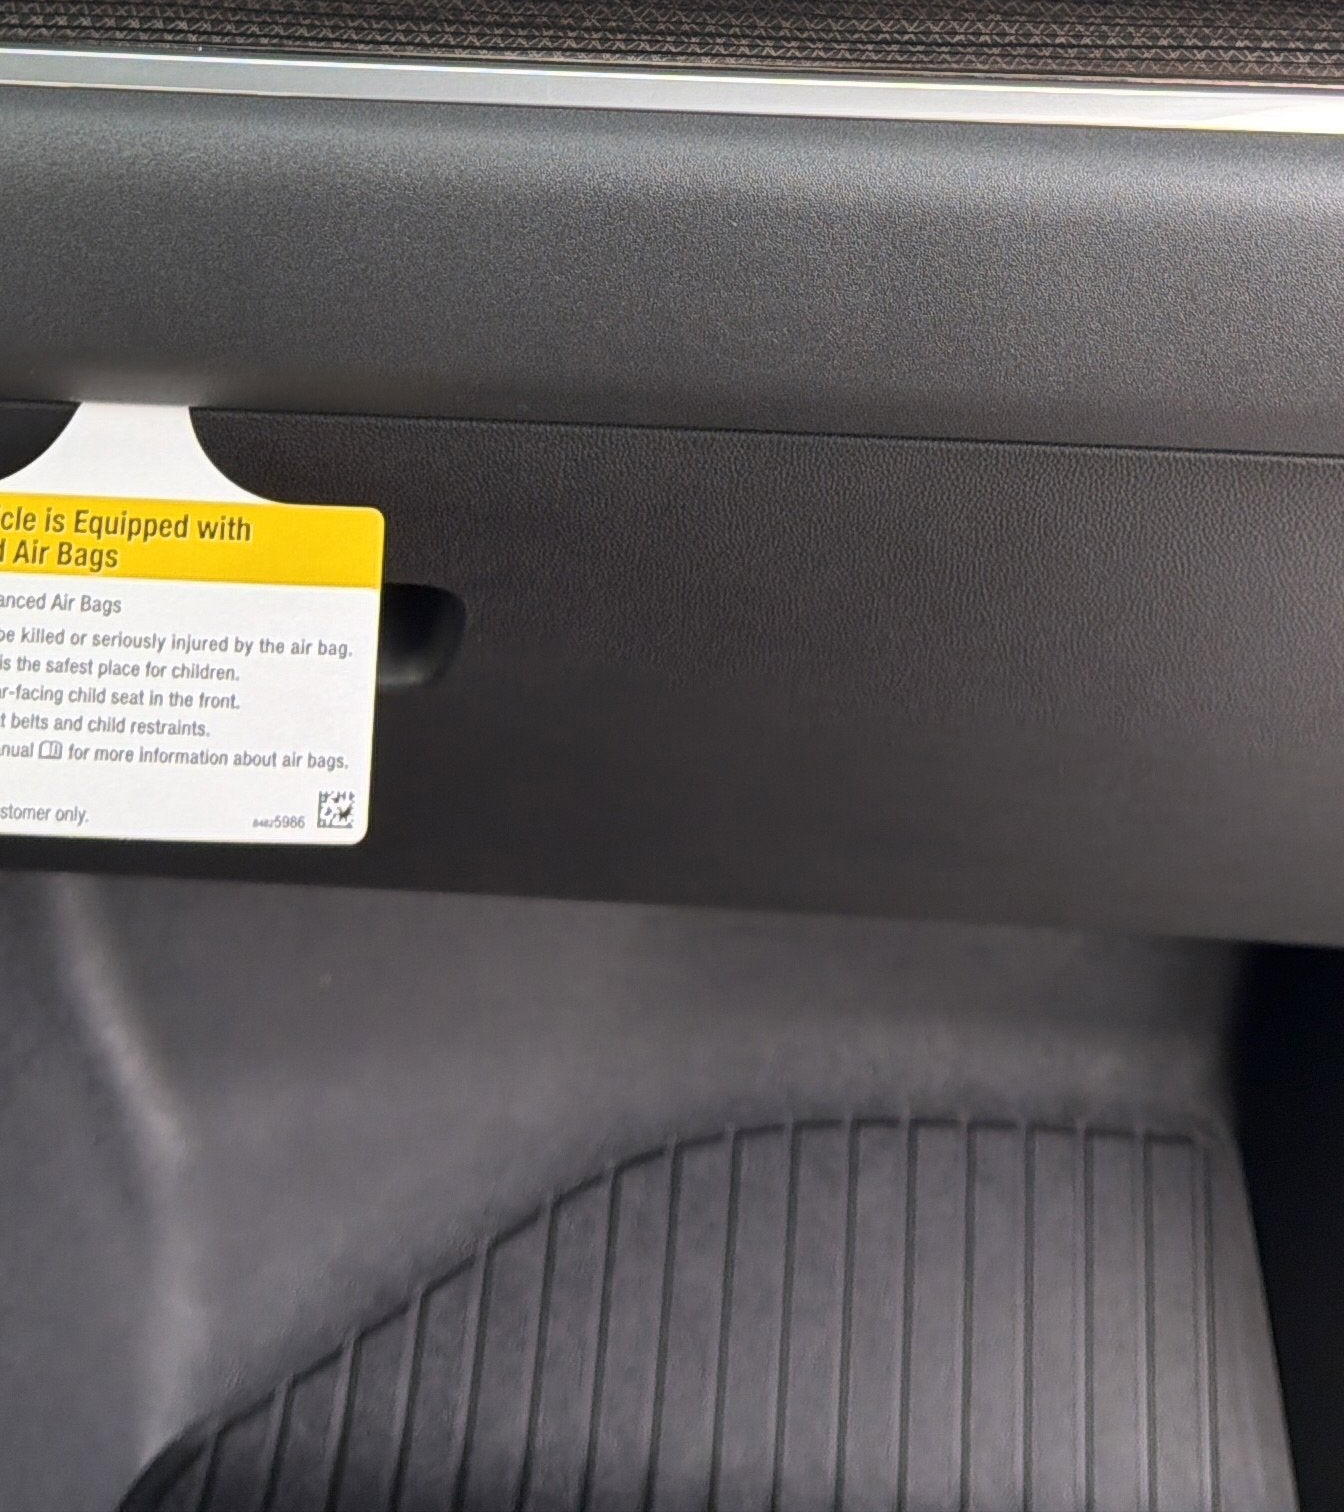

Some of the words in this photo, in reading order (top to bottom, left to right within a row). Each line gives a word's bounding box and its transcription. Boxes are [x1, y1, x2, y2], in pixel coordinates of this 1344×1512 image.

[45, 507, 65, 533] is
[74, 509, 189, 541] Equipped
[197, 515, 251, 541] with
[12, 540, 50, 564] Air
[57, 542, 118, 572] Bags
[50, 593, 76, 611] Air
[80, 594, 122, 616] Bags
[20, 627, 65, 645] killed
[70, 632, 88, 646] or
[92, 631, 166, 652] seriously
[171, 633, 229, 653] injured
[234, 636, 254, 656] by
[259, 638, 285, 654] the
[290, 639, 313, 655] air
[318, 639, 352, 660] bag.
[16, 655, 41, 673] the
[46, 657, 94, 675] safest
[97, 659, 140, 678] place
[145, 661, 167, 678] for
[171, 663, 239, 681] children.
[68, 687, 106, 704] child
[111, 690, 144, 706] seat
[149, 690, 163, 706] in
[168, 691, 194, 708] the
[199, 692, 240, 710] front.
[11, 712, 49, 730] belts
[53, 715, 83, 732] and
[87, 716, 126, 734] child
[130, 719, 210, 737] restraints.
[68, 743, 90, 761] for
[94, 748, 134, 763] more
[139, 746, 228, 766] information
[233, 750, 277, 768] about
[282, 751, 303, 768] air
[307, 752, 348, 772] bags.
[55, 806, 89, 827] only.
